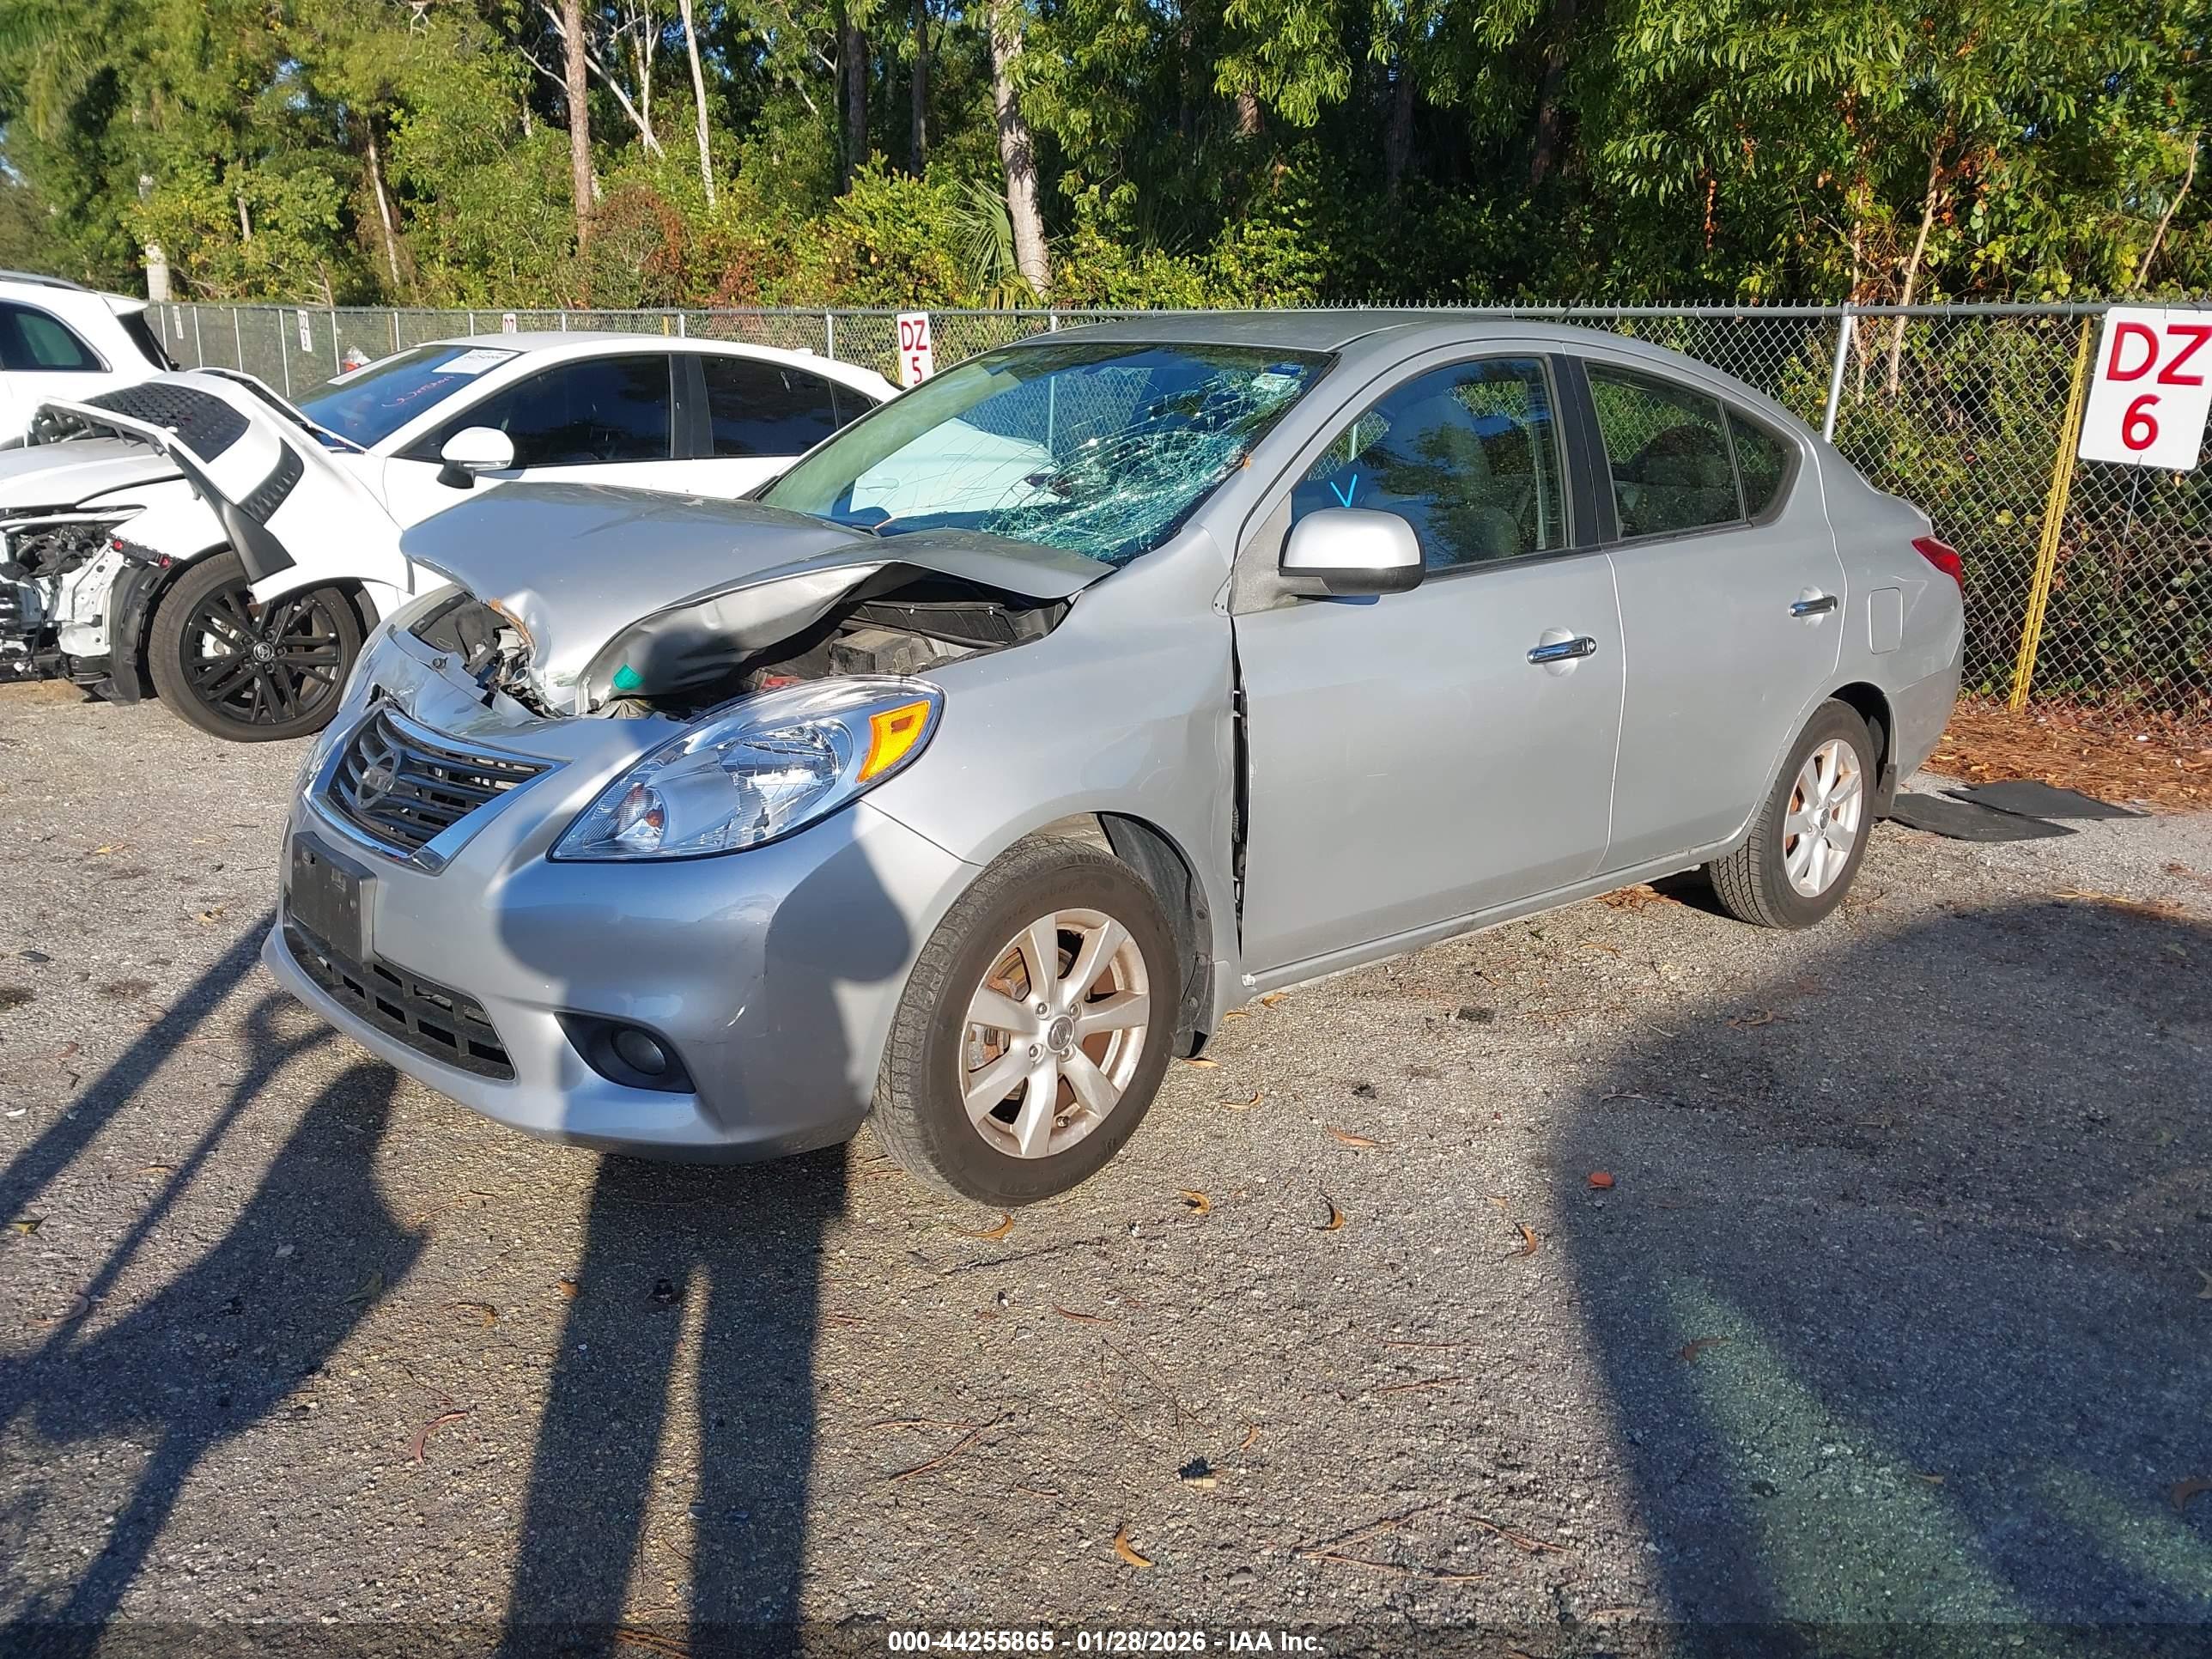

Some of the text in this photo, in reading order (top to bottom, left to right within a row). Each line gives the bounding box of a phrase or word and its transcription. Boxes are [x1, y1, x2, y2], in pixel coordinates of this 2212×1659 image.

[900, 319, 927, 351] DZ
[2106, 321, 2212, 386] DZ
[911, 356, 923, 385] 5
[2121, 392, 2163, 451] 6
